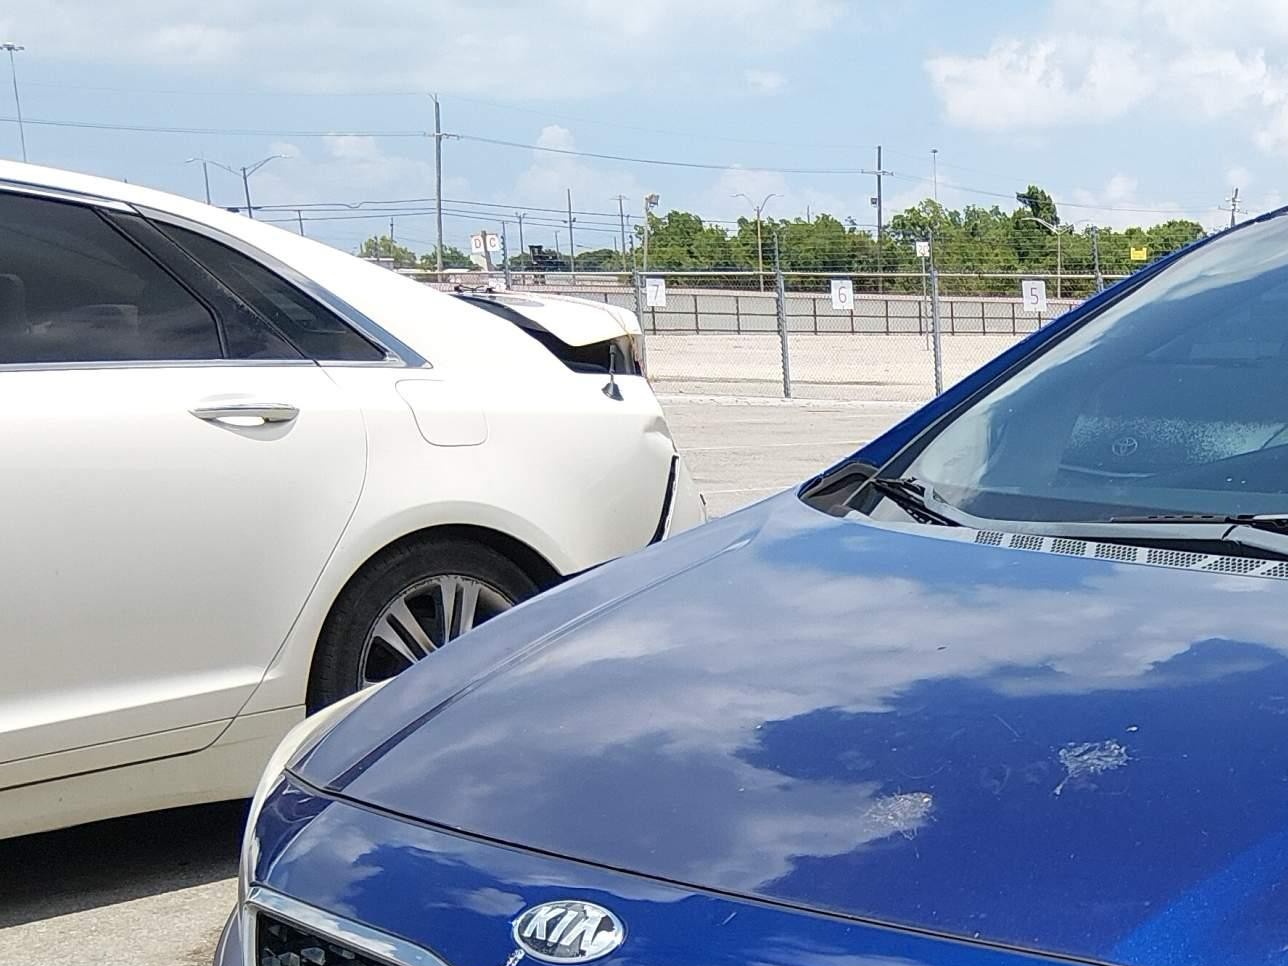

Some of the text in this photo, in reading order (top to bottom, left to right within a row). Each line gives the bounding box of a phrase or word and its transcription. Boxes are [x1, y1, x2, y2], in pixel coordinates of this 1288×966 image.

[474, 238, 482, 249] D
[489, 237, 497, 248] C
[650, 284, 660, 301] 7
[838, 286, 848, 304] 6
[1030, 287, 1040, 305] 5
[523, 905, 603, 951] KIA
